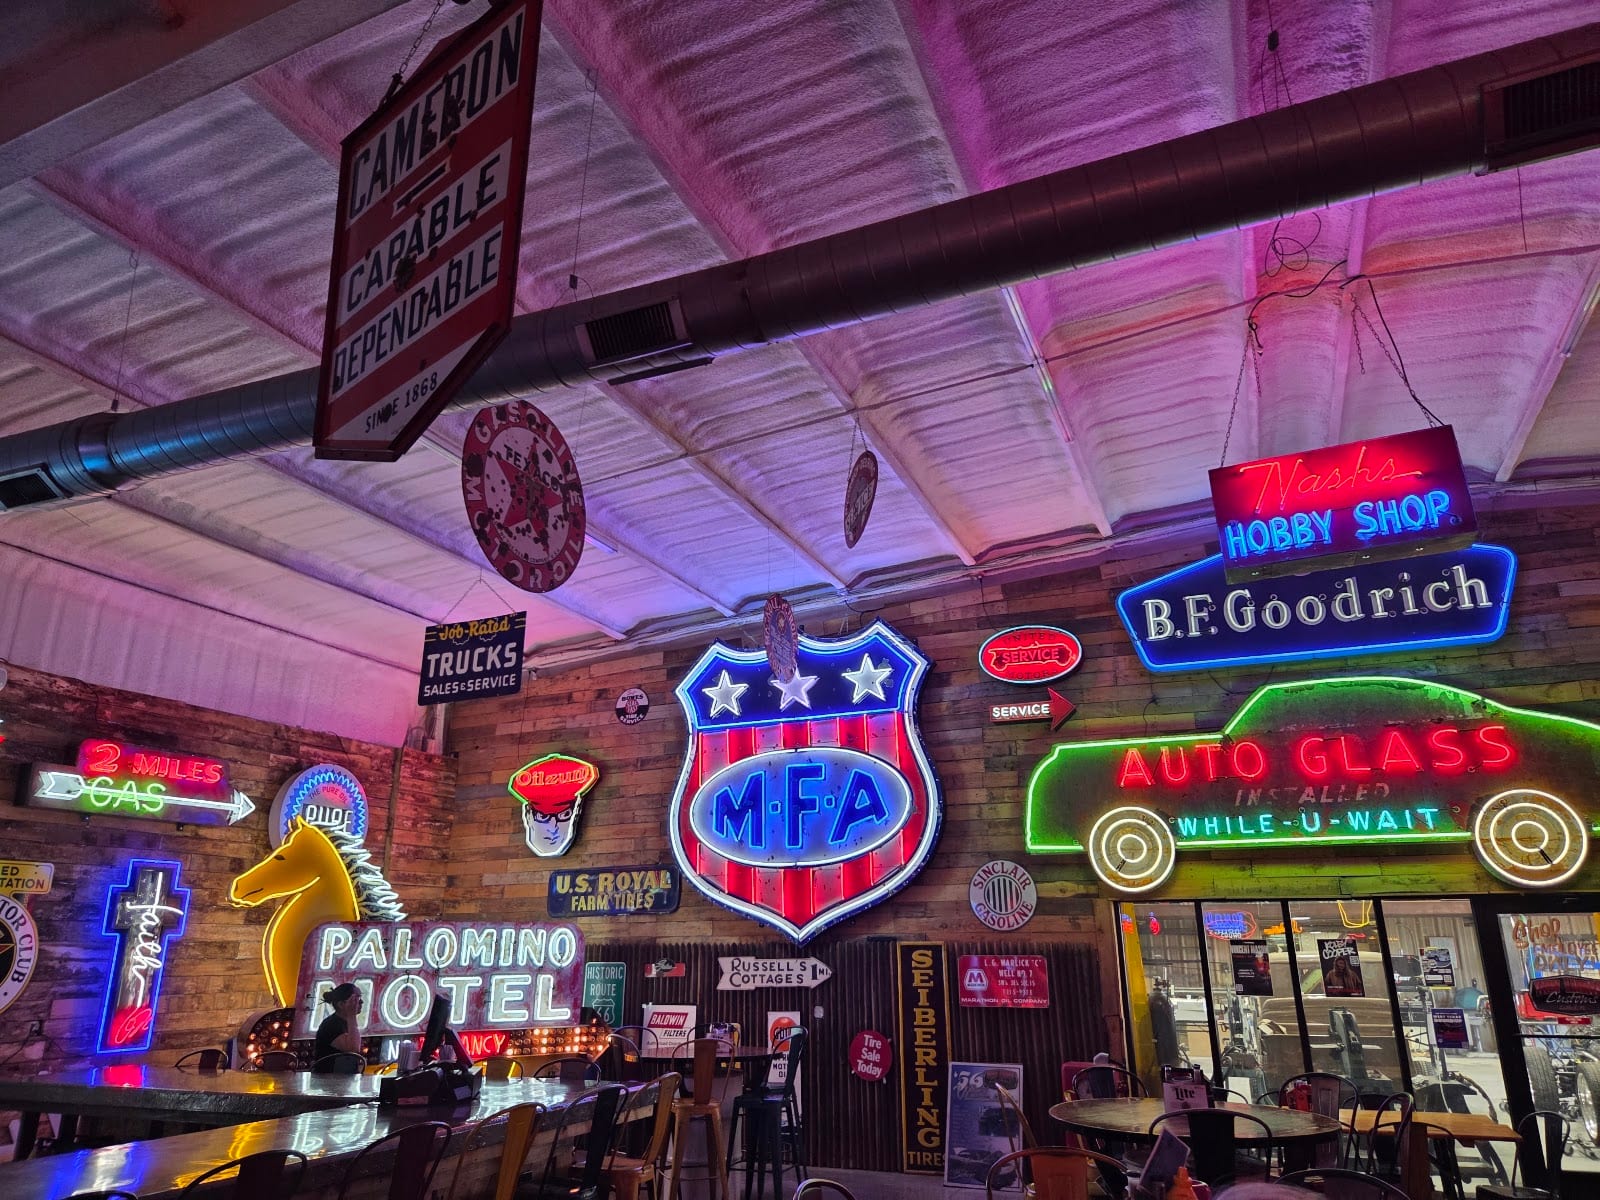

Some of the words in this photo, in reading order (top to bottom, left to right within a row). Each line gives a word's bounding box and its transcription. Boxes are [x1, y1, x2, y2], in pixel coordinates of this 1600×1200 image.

[350, 15, 523, 221] CAMERON
[346, 154, 501, 312] CAPABLE
[332, 229, 503, 394] DEPENDABLE
[404, 372, 439, 410] 1868
[504, 444, 560, 492] TEXACO
[1224, 509, 1332, 559] HOBBY
[1353, 490, 1451, 541] SHOP
[427, 641, 518, 679] TRUCKS
[1002, 648, 1060, 662] SERVICE
[992, 704, 1050, 718] SERVICE
[93, 744, 122, 773] 2
[132, 753, 224, 784] MILES
[1119, 741, 1266, 787] AUTO
[1300, 726, 1513, 776] GLASS
[89, 776, 167, 812] GAS
[309, 789, 321, 799] THE
[322, 786, 339, 795] PURE
[1234, 783, 1390, 807] INSTALLED
[306, 804, 354, 833] PURE
[556, 873, 593, 894] U.S.
[597, 869, 672, 893] ROYAL
[973, 861, 1032, 891] SINCLAIR
[571, 894, 609, 912] FARM
[614, 892, 655, 910] TIRES
[974, 902, 1034, 928] GASOLINE
[11, 933, 33, 984] CLUB
[318, 926, 577, 970] PALOMINO
[1322, 947, 1357, 960] COOPER
[586, 967, 624, 980] HISTORIC
[731, 957, 807, 972] RUSSELL'S
[811, 963, 819, 980] 1
[590, 983, 616, 996] ROUTE
[729, 972, 804, 987] COTTAGES
[968, 972, 984, 983] M
[308, 972, 571, 1033] MOTEL
[650, 1014, 686, 1026] BALDWIN
[663, 1029, 688, 1038] FILTERS
[863, 1034, 882, 1049] Tire
[861, 1048, 881, 1062] Sale
[910, 949, 941, 1148] SEIBERLING
[857, 1060, 882, 1078] Today
[1174, 1087, 1196, 1101] Lite
